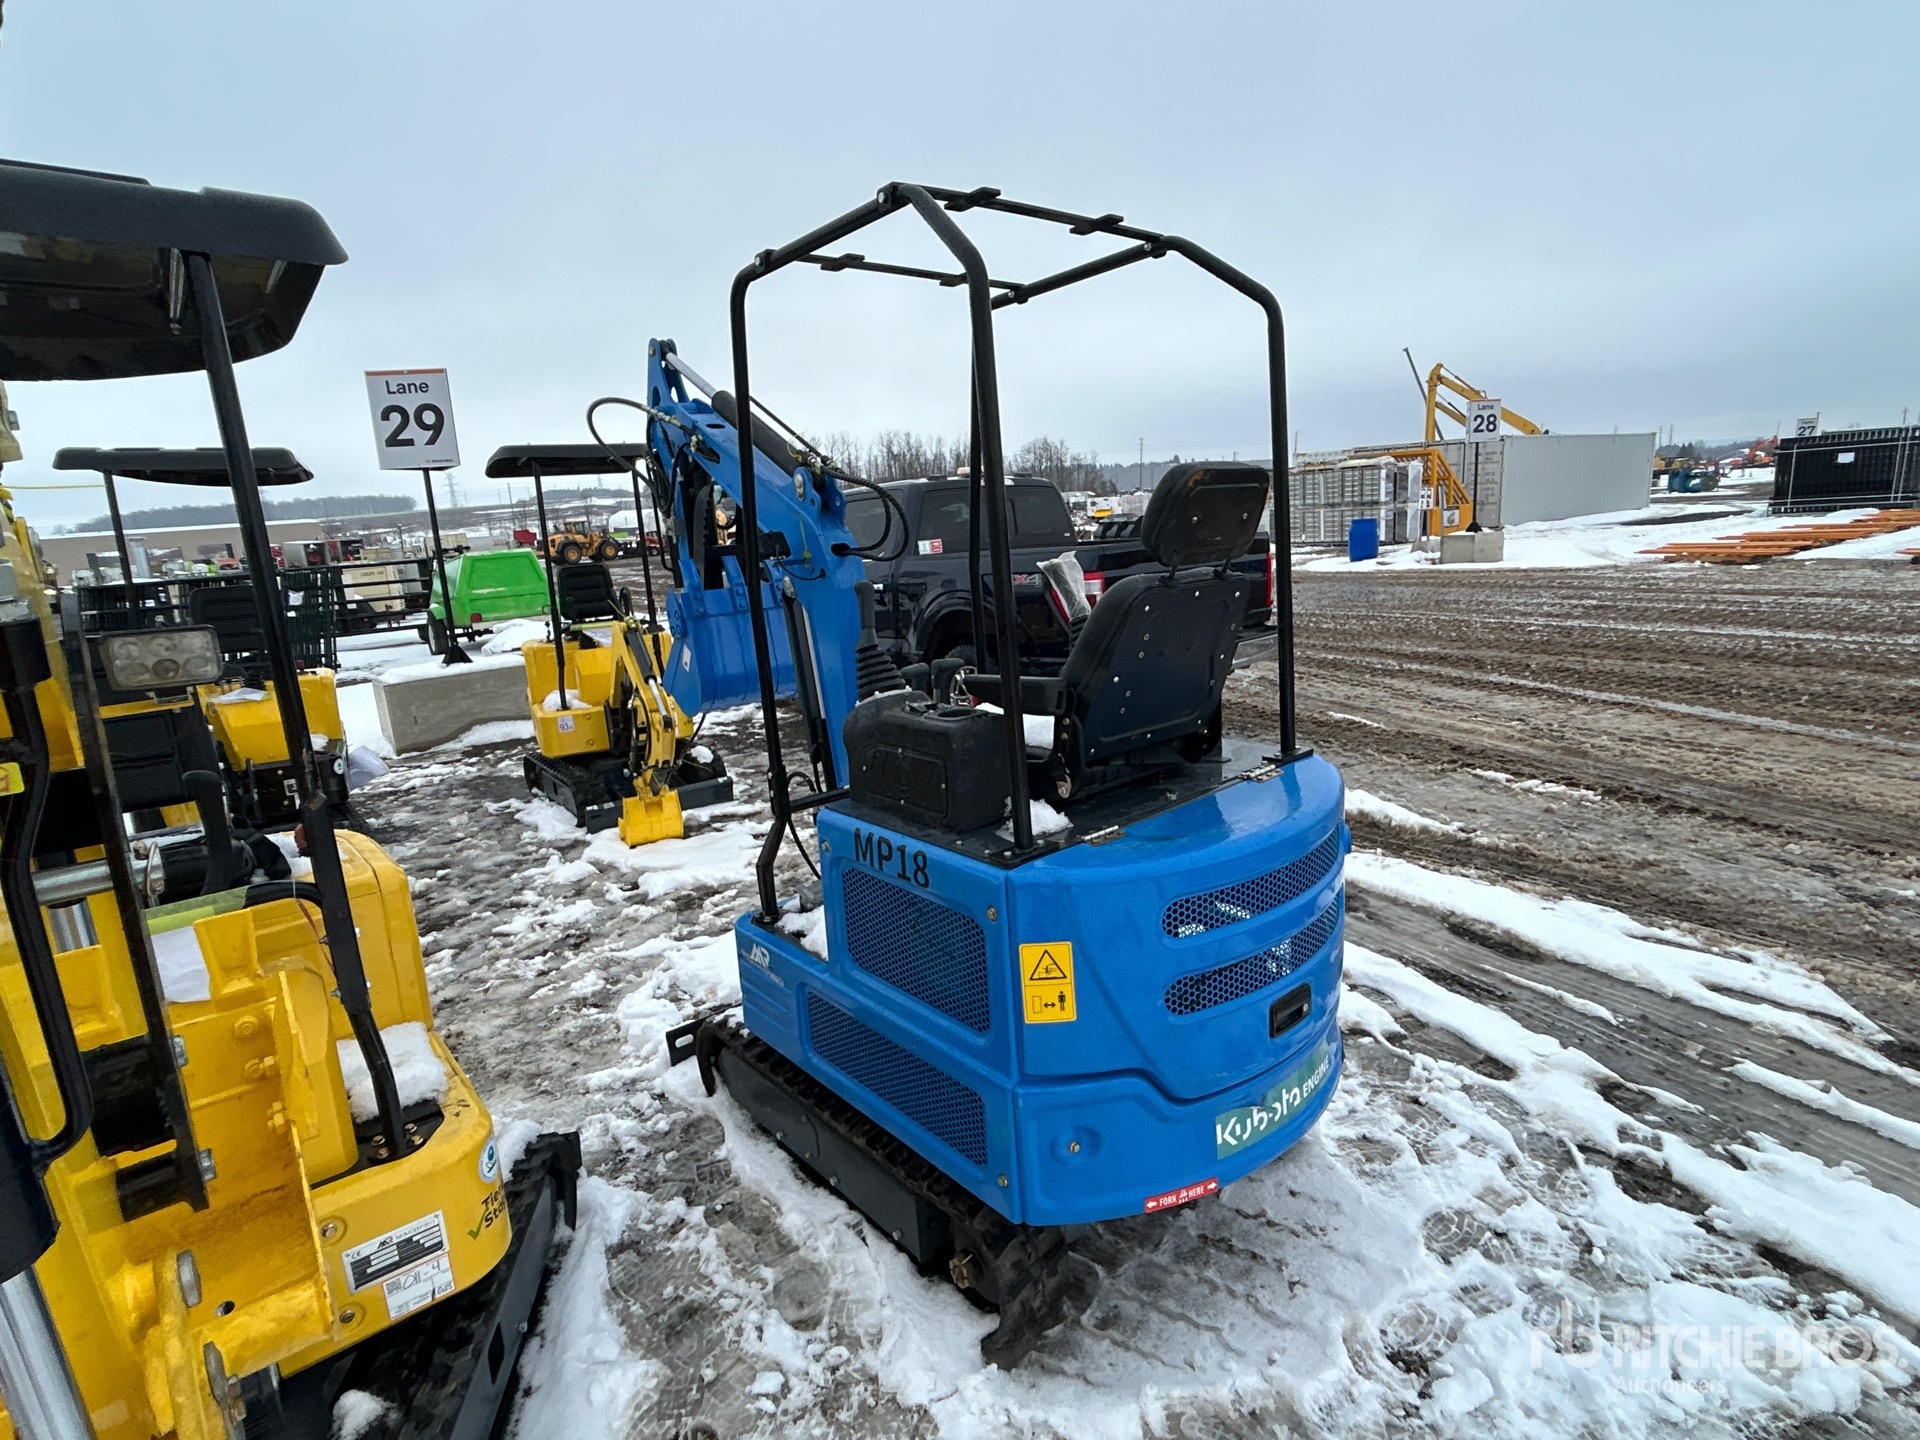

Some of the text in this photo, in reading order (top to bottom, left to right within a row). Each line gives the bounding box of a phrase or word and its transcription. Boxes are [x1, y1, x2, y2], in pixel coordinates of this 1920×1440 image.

[385, 380, 429, 395] Lane
[1477, 403, 1494, 411] Lane
[380, 402, 445, 447] 29
[1473, 413, 1498, 433] 28
[1797, 425, 1816, 437] 27
[854, 826, 930, 889] MP18
[1216, 1054, 1330, 1146] Kubota ENGINE
[1159, 1185, 1206, 1207] FORK HERE
